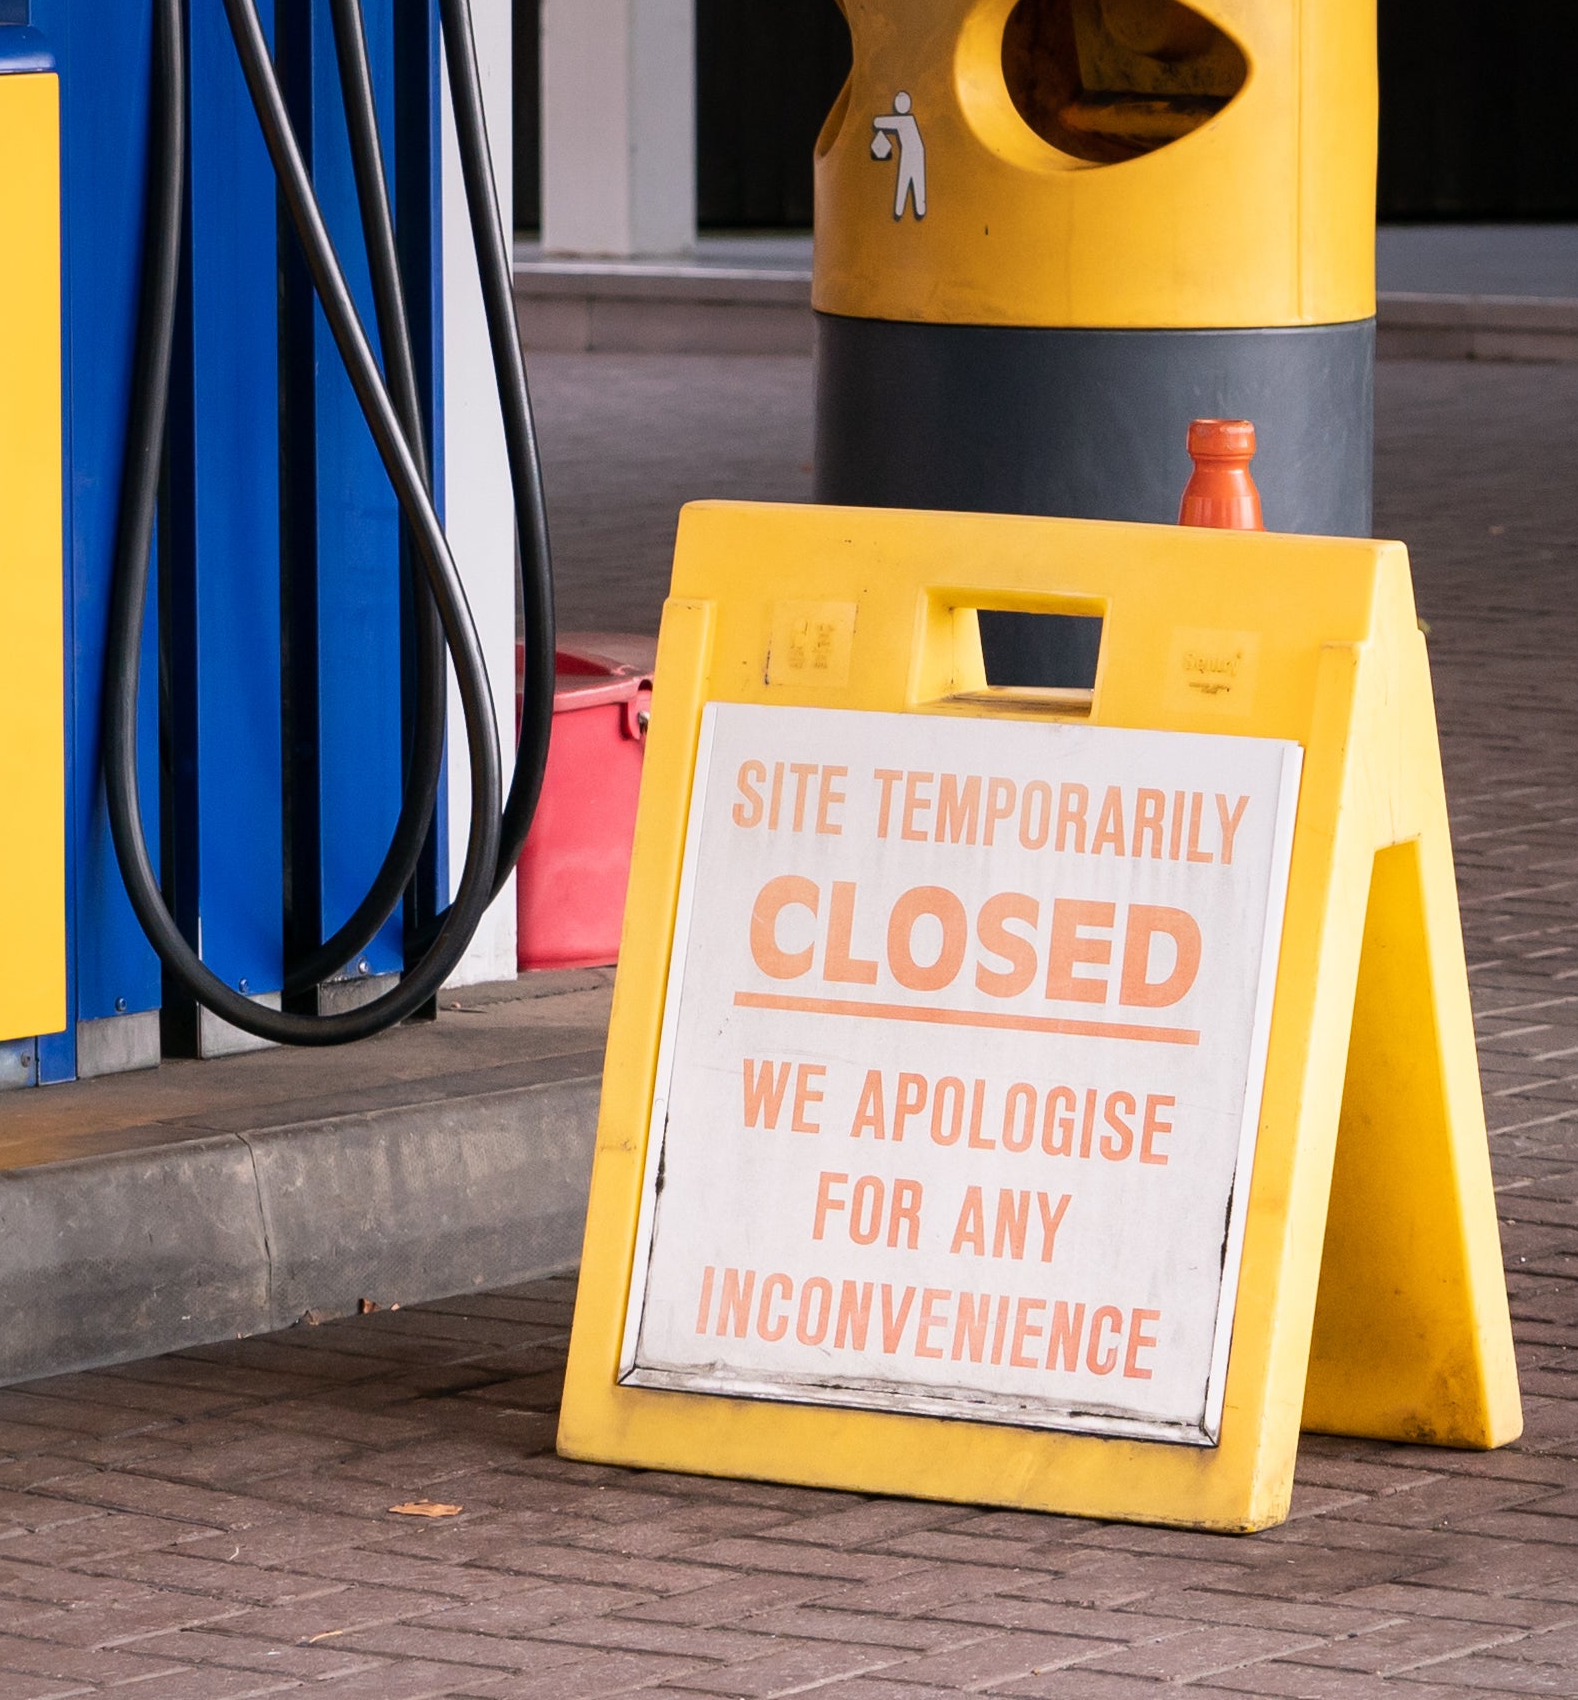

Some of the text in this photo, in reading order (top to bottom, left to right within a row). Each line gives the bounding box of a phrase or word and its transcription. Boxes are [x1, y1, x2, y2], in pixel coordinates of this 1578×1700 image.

[731, 759, 1251, 865] SITE TEMPORARILY
[748, 874, 1202, 1009] CLOSED
[741, 1058, 1176, 1166] WE APOLOGISE
[812, 1171, 1073, 1264] FOR ANY
[694, 1265, 1161, 1381] INCONVENIENCE
